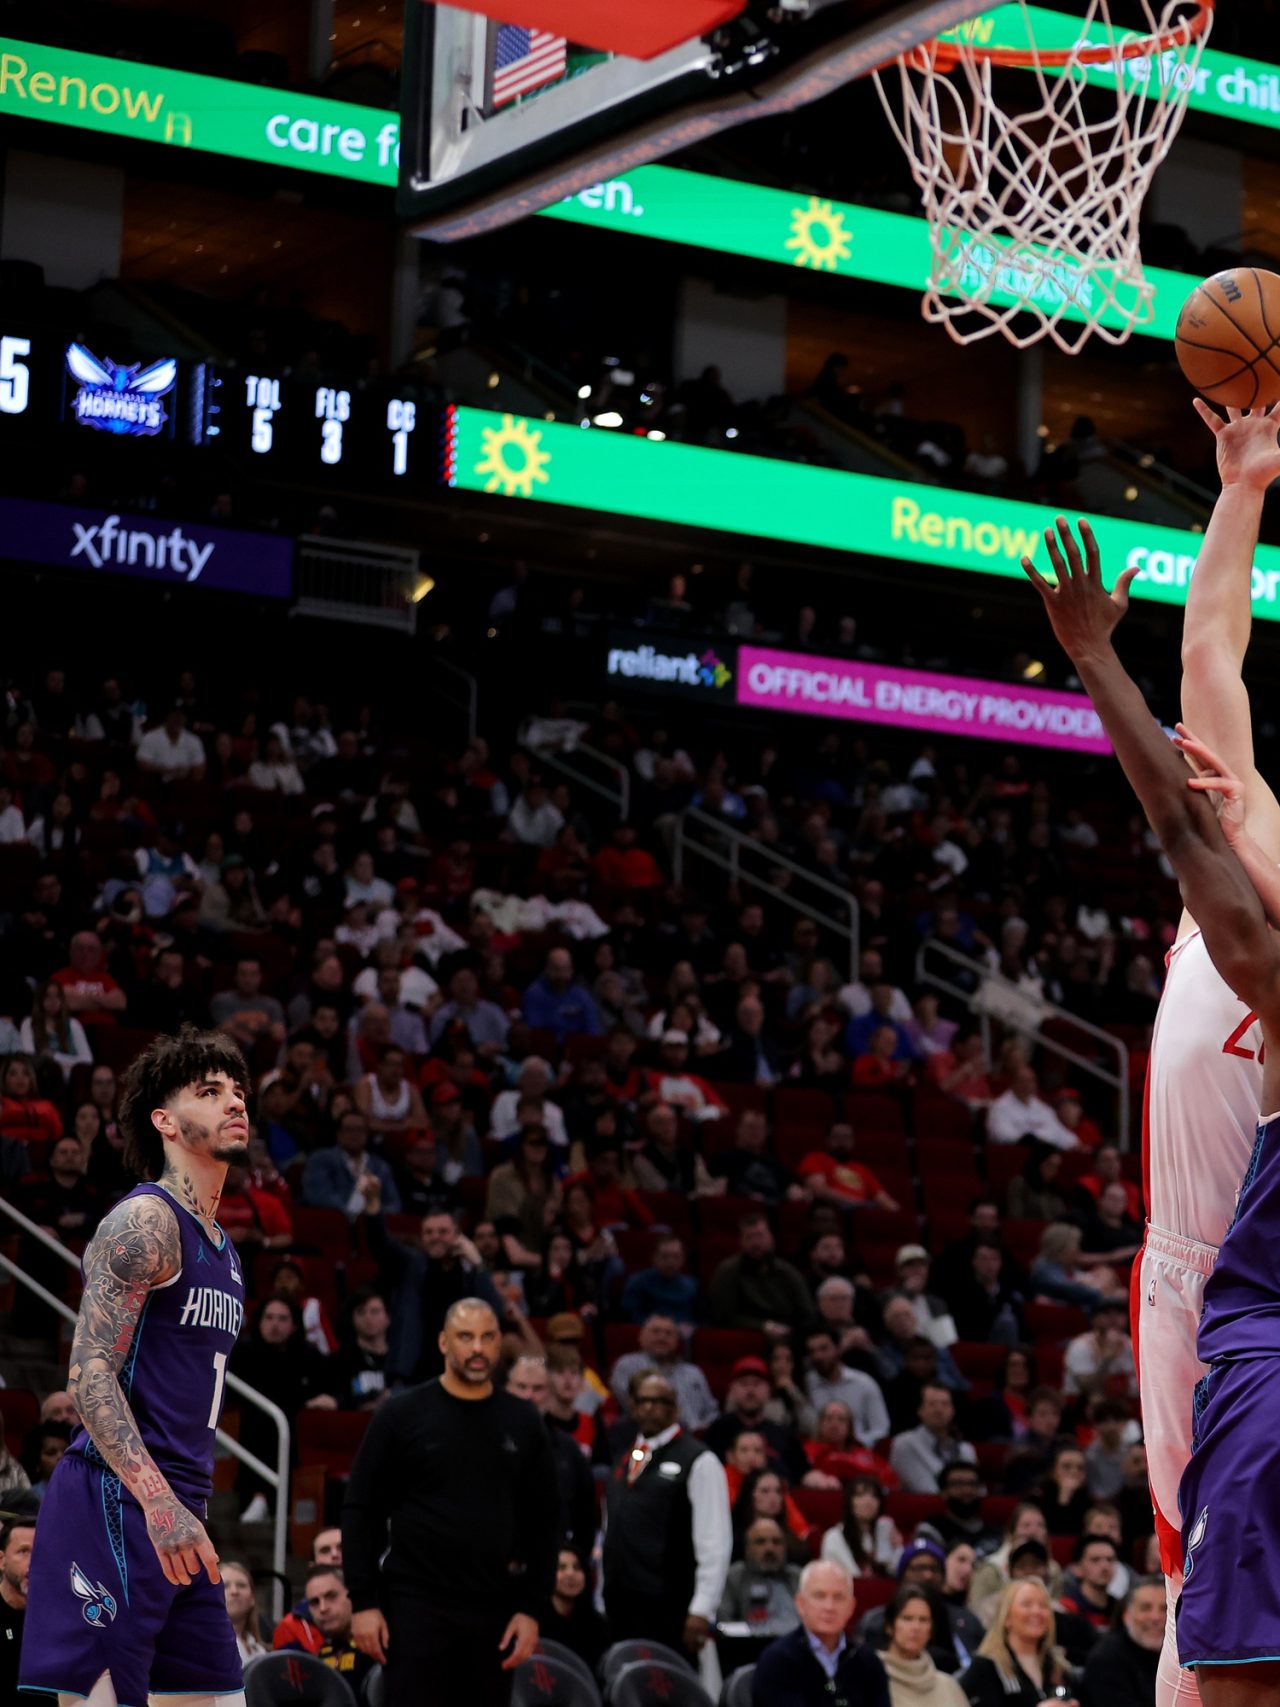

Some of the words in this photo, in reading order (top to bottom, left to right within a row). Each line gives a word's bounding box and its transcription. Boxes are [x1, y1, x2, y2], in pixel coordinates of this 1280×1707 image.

[265, 114, 366, 162] care
[315, 386, 351, 422] FLS
[251, 407, 273, 453] 5
[392, 430, 408, 476] 1
[70, 514, 215, 582] xfinity
[1126, 547, 1198, 587] car
[607, 644, 701, 686] reliant
[748, 662, 872, 708] OFFICIAL
[876, 680, 978, 722] ENERGY
[207, 1351, 228, 1431] 1
